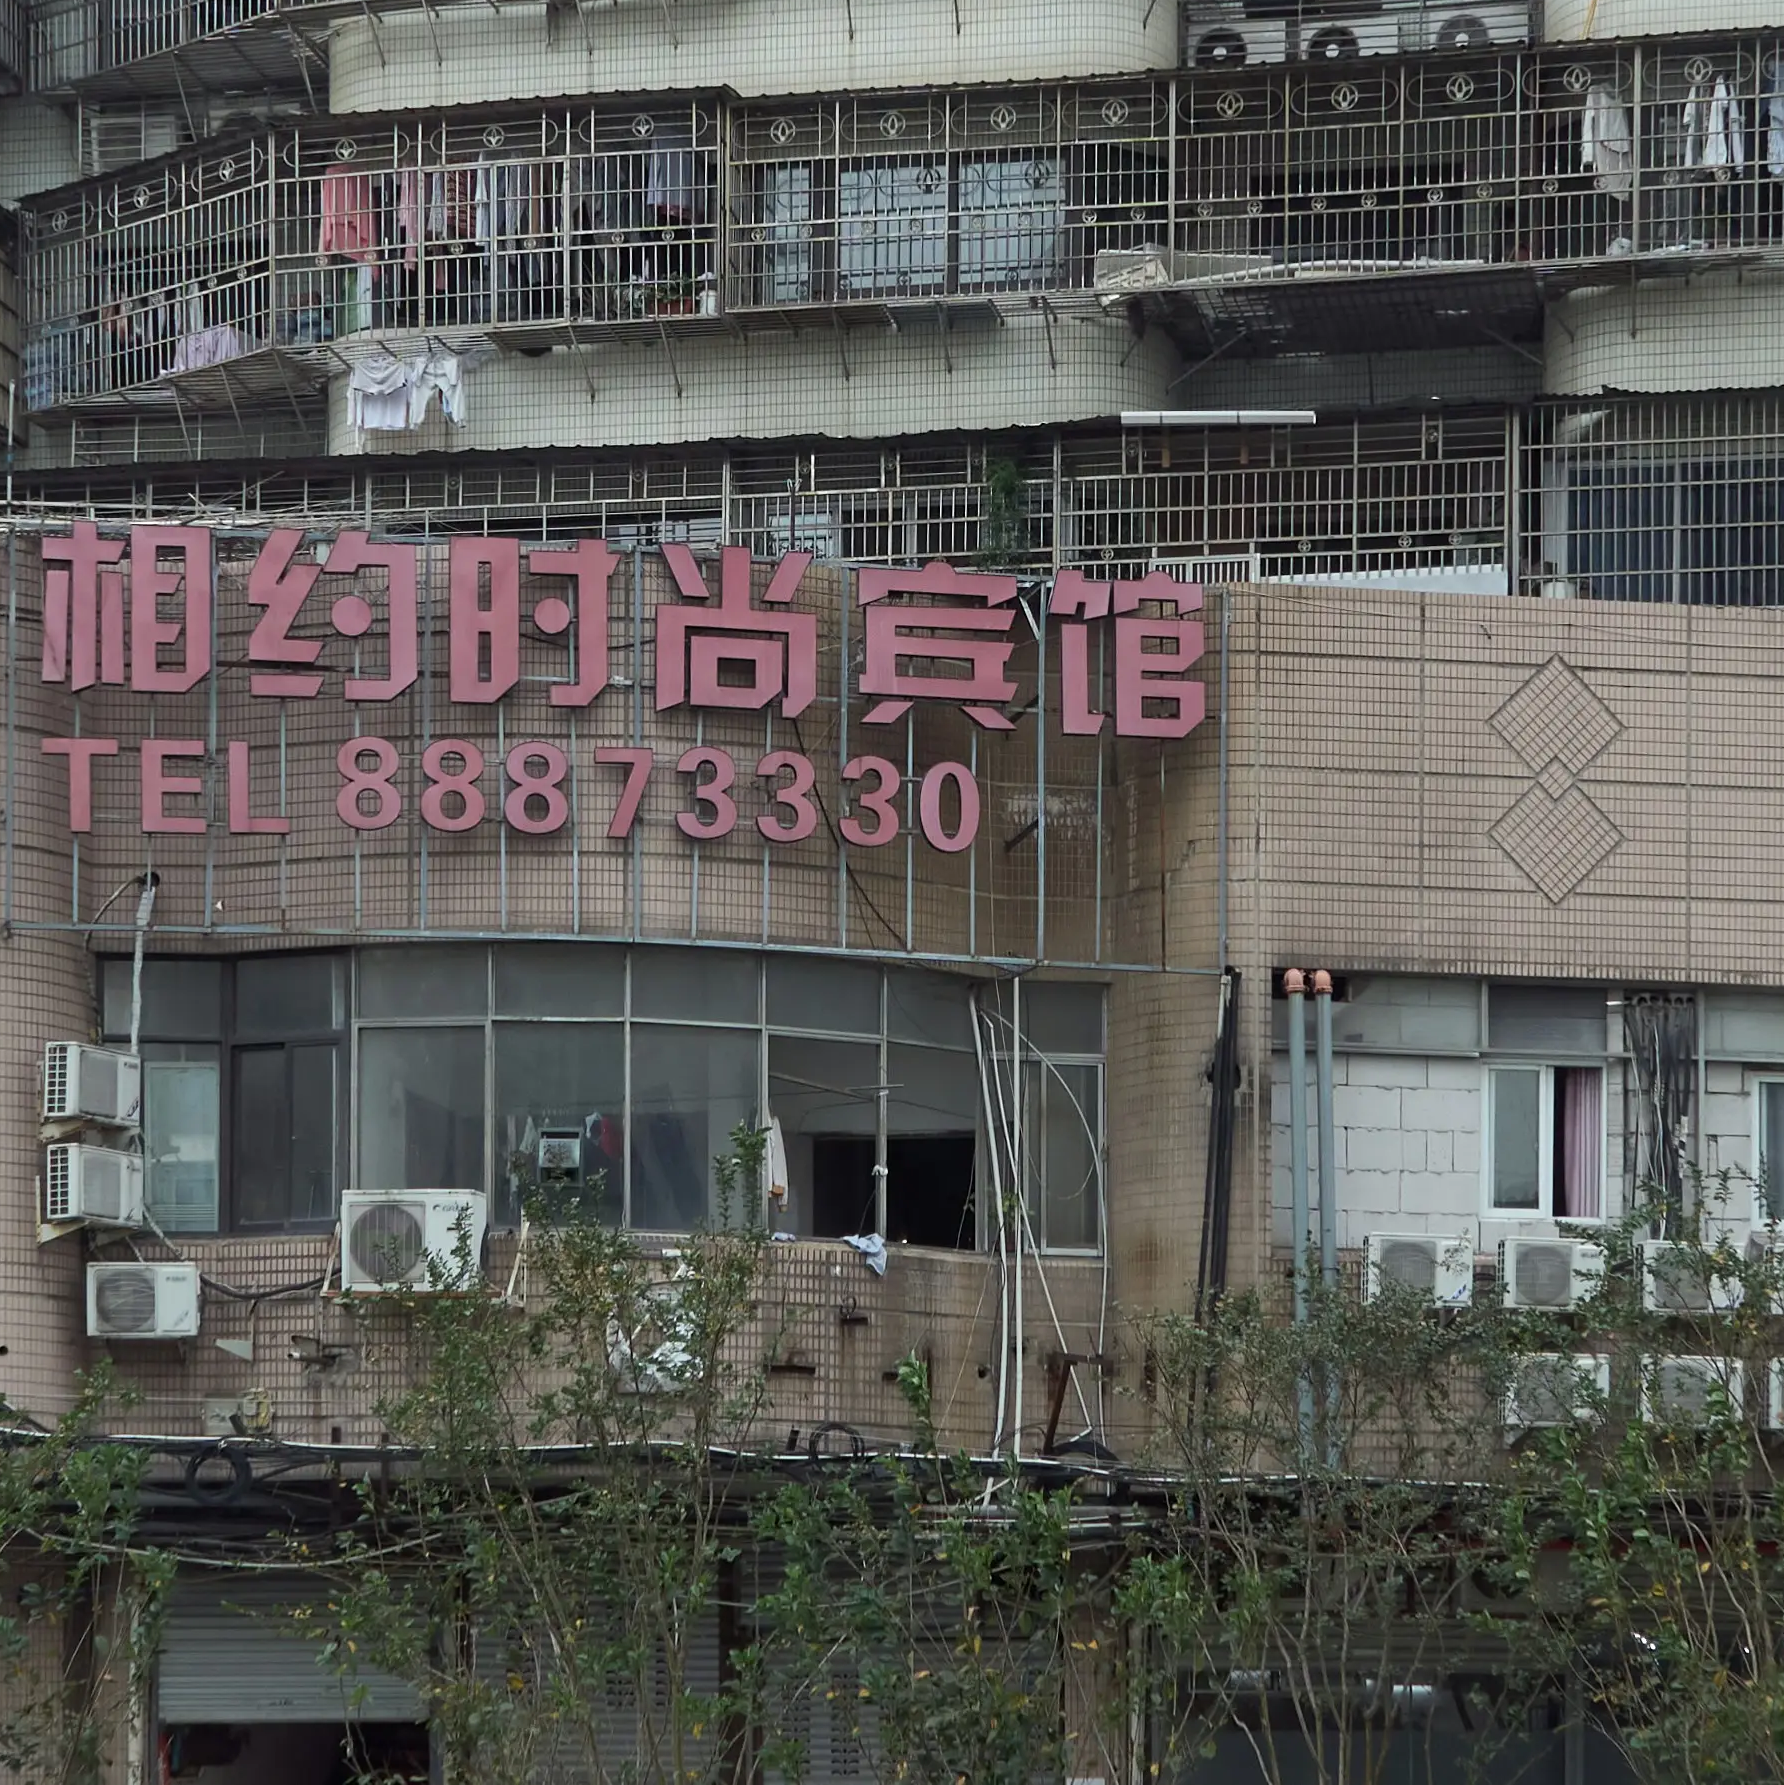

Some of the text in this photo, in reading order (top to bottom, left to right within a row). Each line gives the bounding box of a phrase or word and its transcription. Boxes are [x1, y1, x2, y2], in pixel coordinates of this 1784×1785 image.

[42, 521, 1205, 738] 相约时尚宾馆
[41, 736, 980, 853] TEL 88873330
